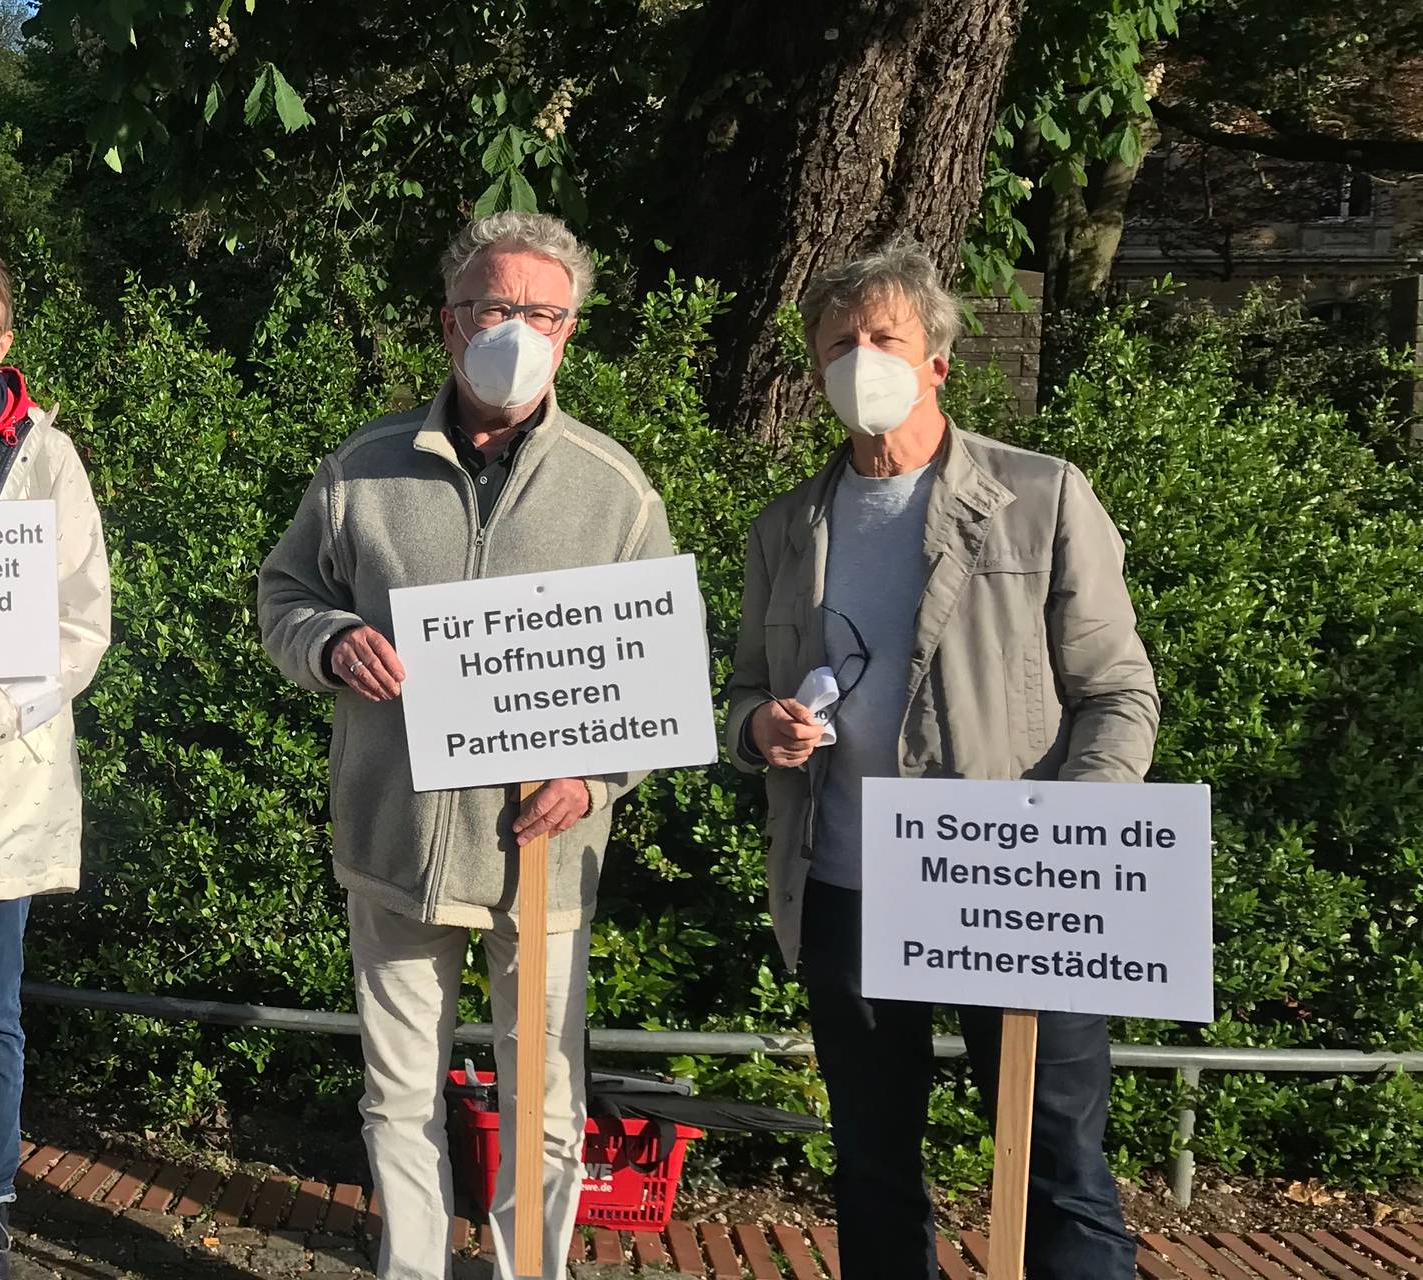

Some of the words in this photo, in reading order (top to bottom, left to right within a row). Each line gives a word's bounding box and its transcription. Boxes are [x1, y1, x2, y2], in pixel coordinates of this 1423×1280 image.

[422, 617, 474, 642] Für
[484, 603, 602, 636] Frieden
[614, 590, 674, 621] und
[460, 644, 605, 677] Hoffnung
[616, 637, 645, 661] in
[493, 683, 621, 714] unseren
[446, 716, 679, 758] Partnerstädten
[895, 813, 924, 839] In
[936, 814, 1040, 850] Sorge
[1052, 824, 1107, 846] um
[1120, 821, 1177, 849] die
[921, 856, 1101, 890] Menschen
[1115, 864, 1147, 893] in
[960, 907, 1104, 935] unseren
[903, 940, 1168, 984] Partnerstädten
[581, 1182, 613, 1192] ewe.de
[585, 1162, 614, 1181] WE
